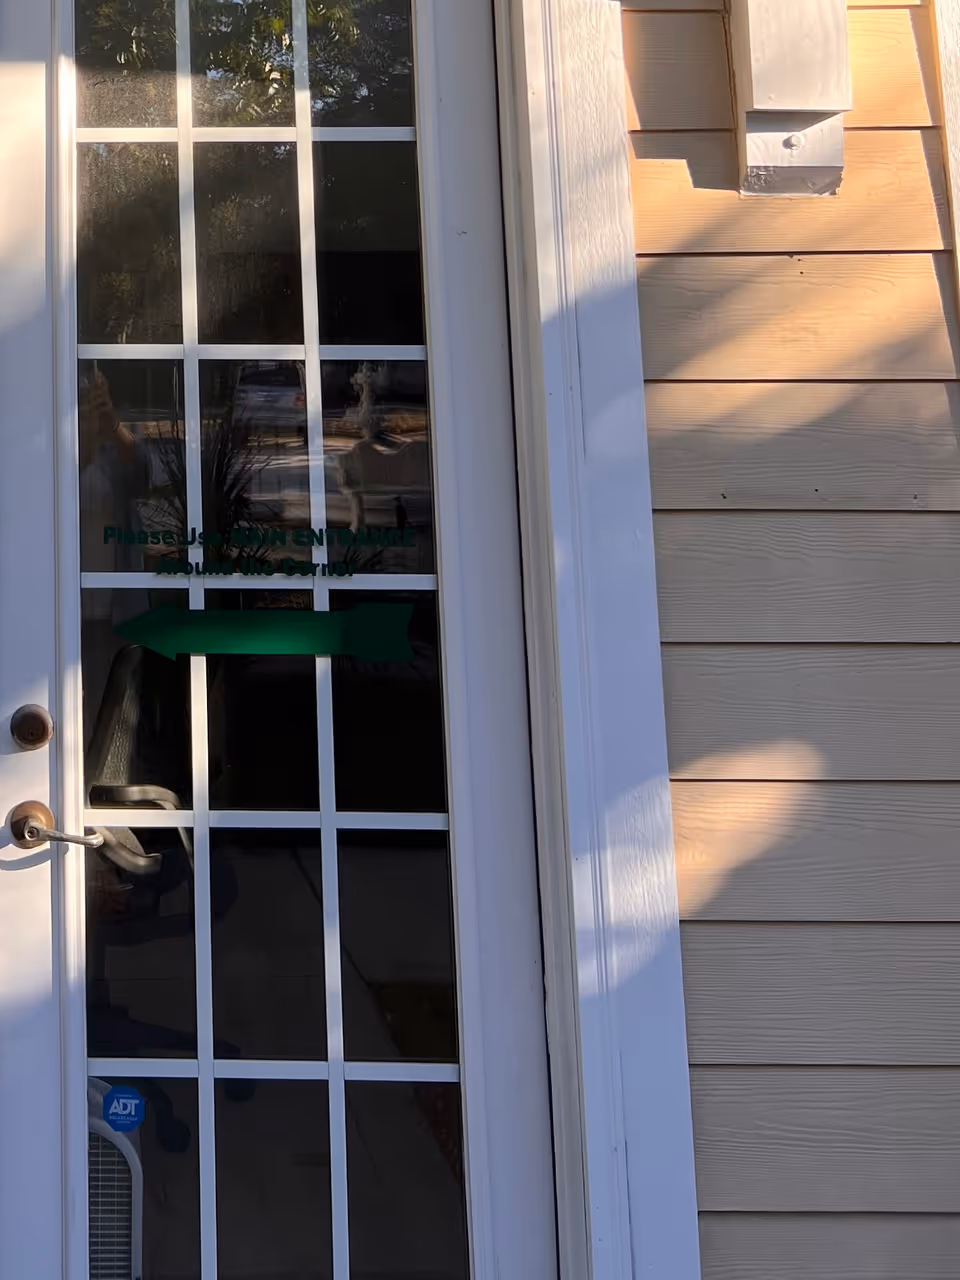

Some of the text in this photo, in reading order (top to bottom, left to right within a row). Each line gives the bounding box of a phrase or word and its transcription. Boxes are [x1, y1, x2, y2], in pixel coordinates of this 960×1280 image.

[103, 526, 176, 547] Please
[181, 527, 224, 547] Use
[228, 527, 288, 546] MAIN
[108, 1097, 140, 1116] ADT
